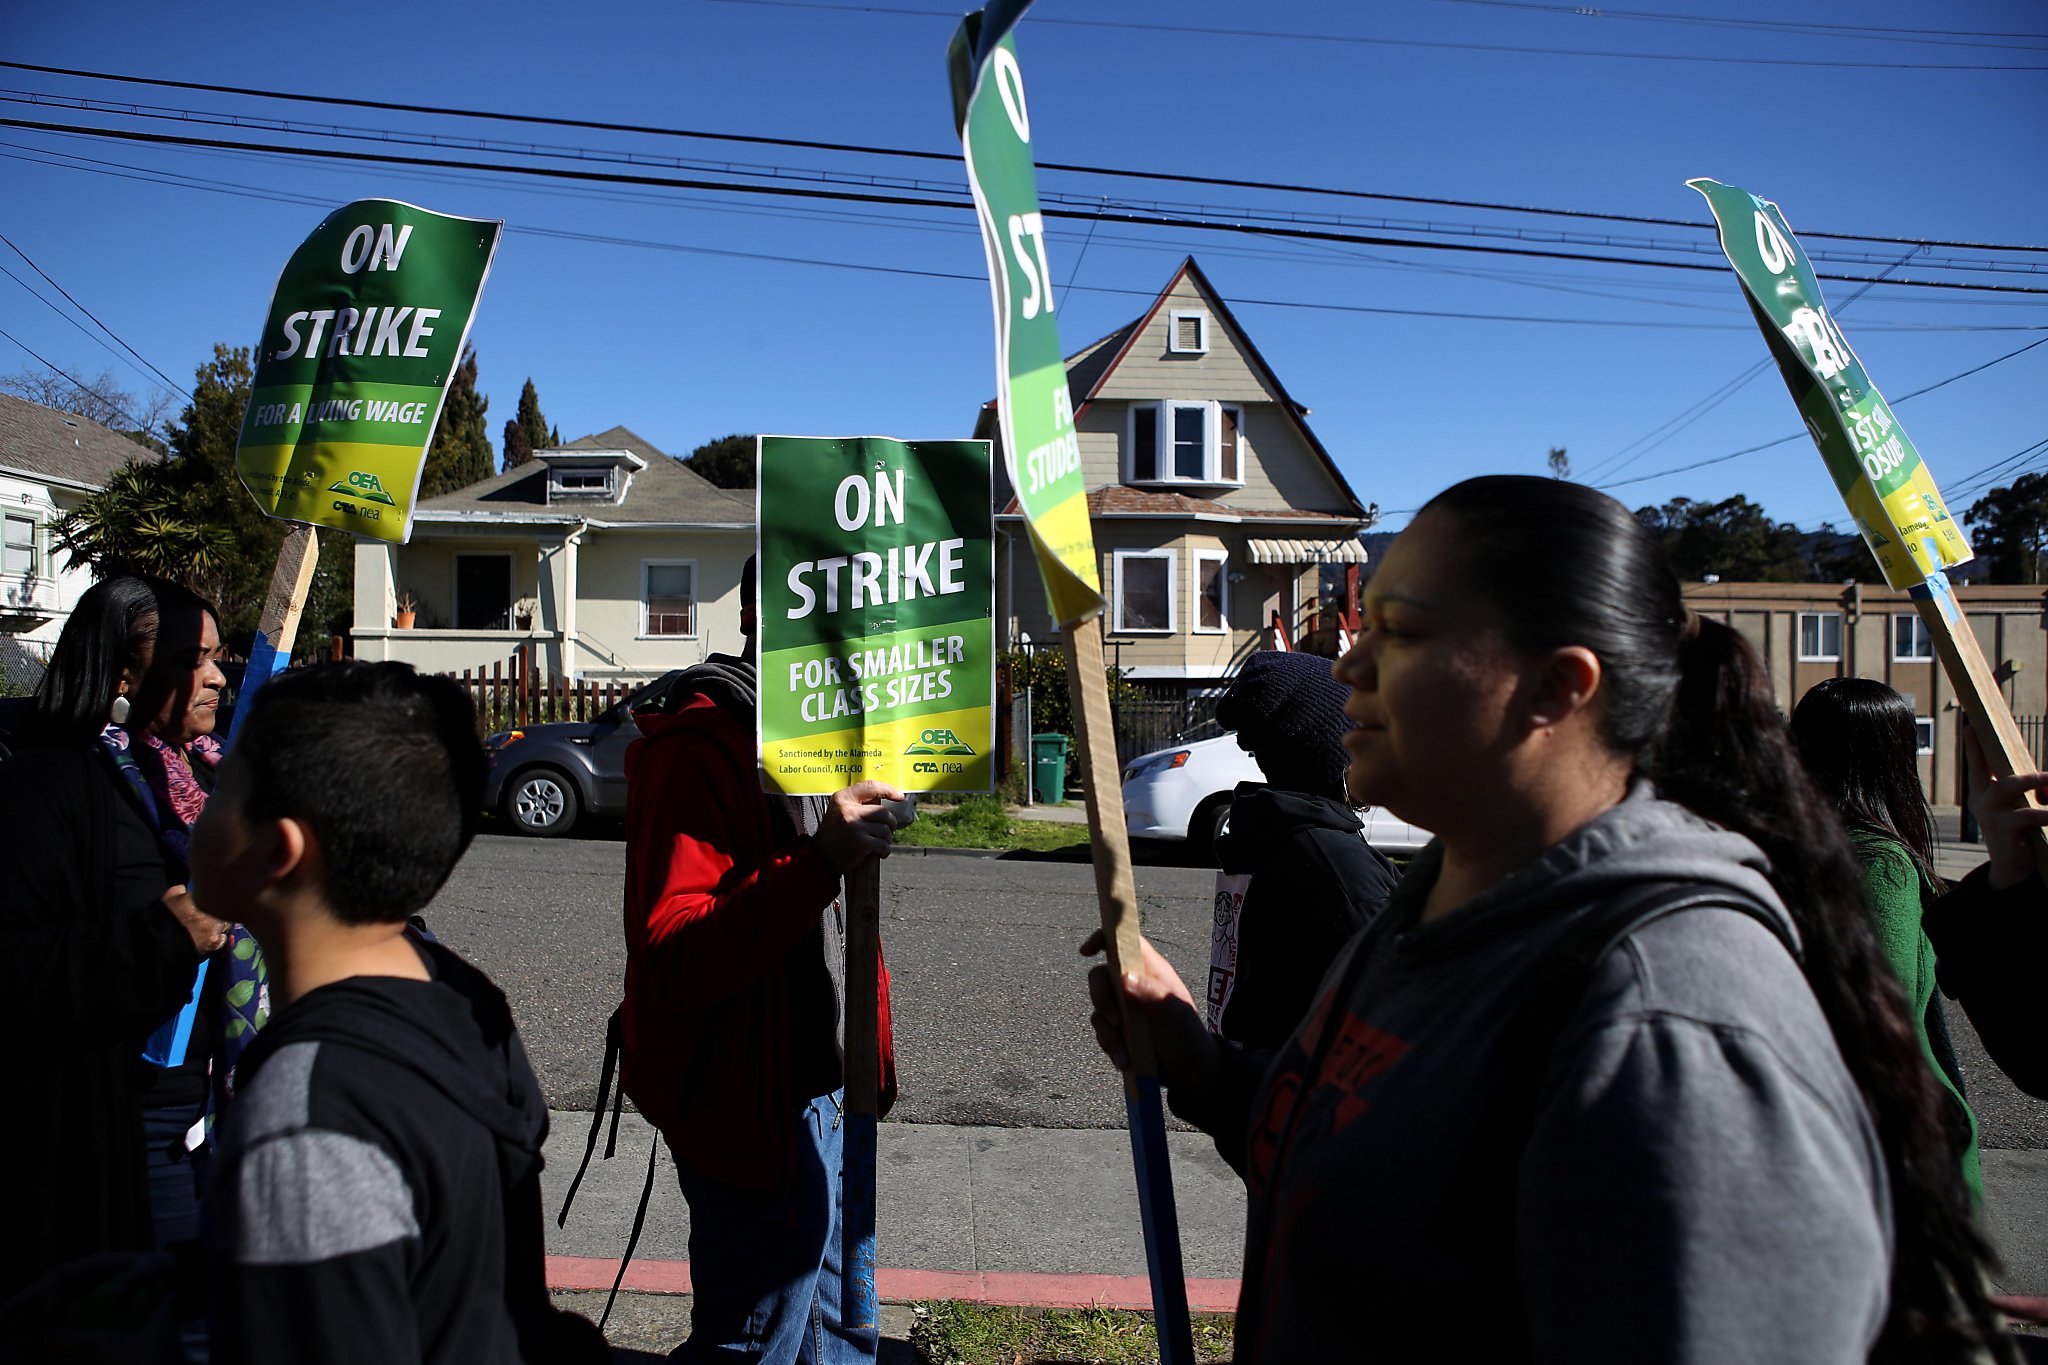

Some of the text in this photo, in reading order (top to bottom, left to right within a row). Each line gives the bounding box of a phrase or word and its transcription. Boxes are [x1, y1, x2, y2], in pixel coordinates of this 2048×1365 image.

[340, 223, 414, 275] ON
[275, 306, 442, 361] STRIKE
[255, 403, 286, 426] FOR
[287, 402, 302, 424] A
[365, 400, 428, 424] WAGE
[348, 470, 384, 493] OEA
[359, 506, 380, 521] nea
[833, 469, 905, 533] ON
[786, 537, 966, 621] STRIKE
[789, 635, 965, 693] FOR SMALLER
[800, 668, 953, 723] CLASS SIZES
[919, 729, 961, 746] OEA
[779, 749, 882, 760] Sanctioned by the Alameda
[779, 764, 863, 775] Labor Council, AFL-CIO
[913, 762, 963, 774] CTA nea
